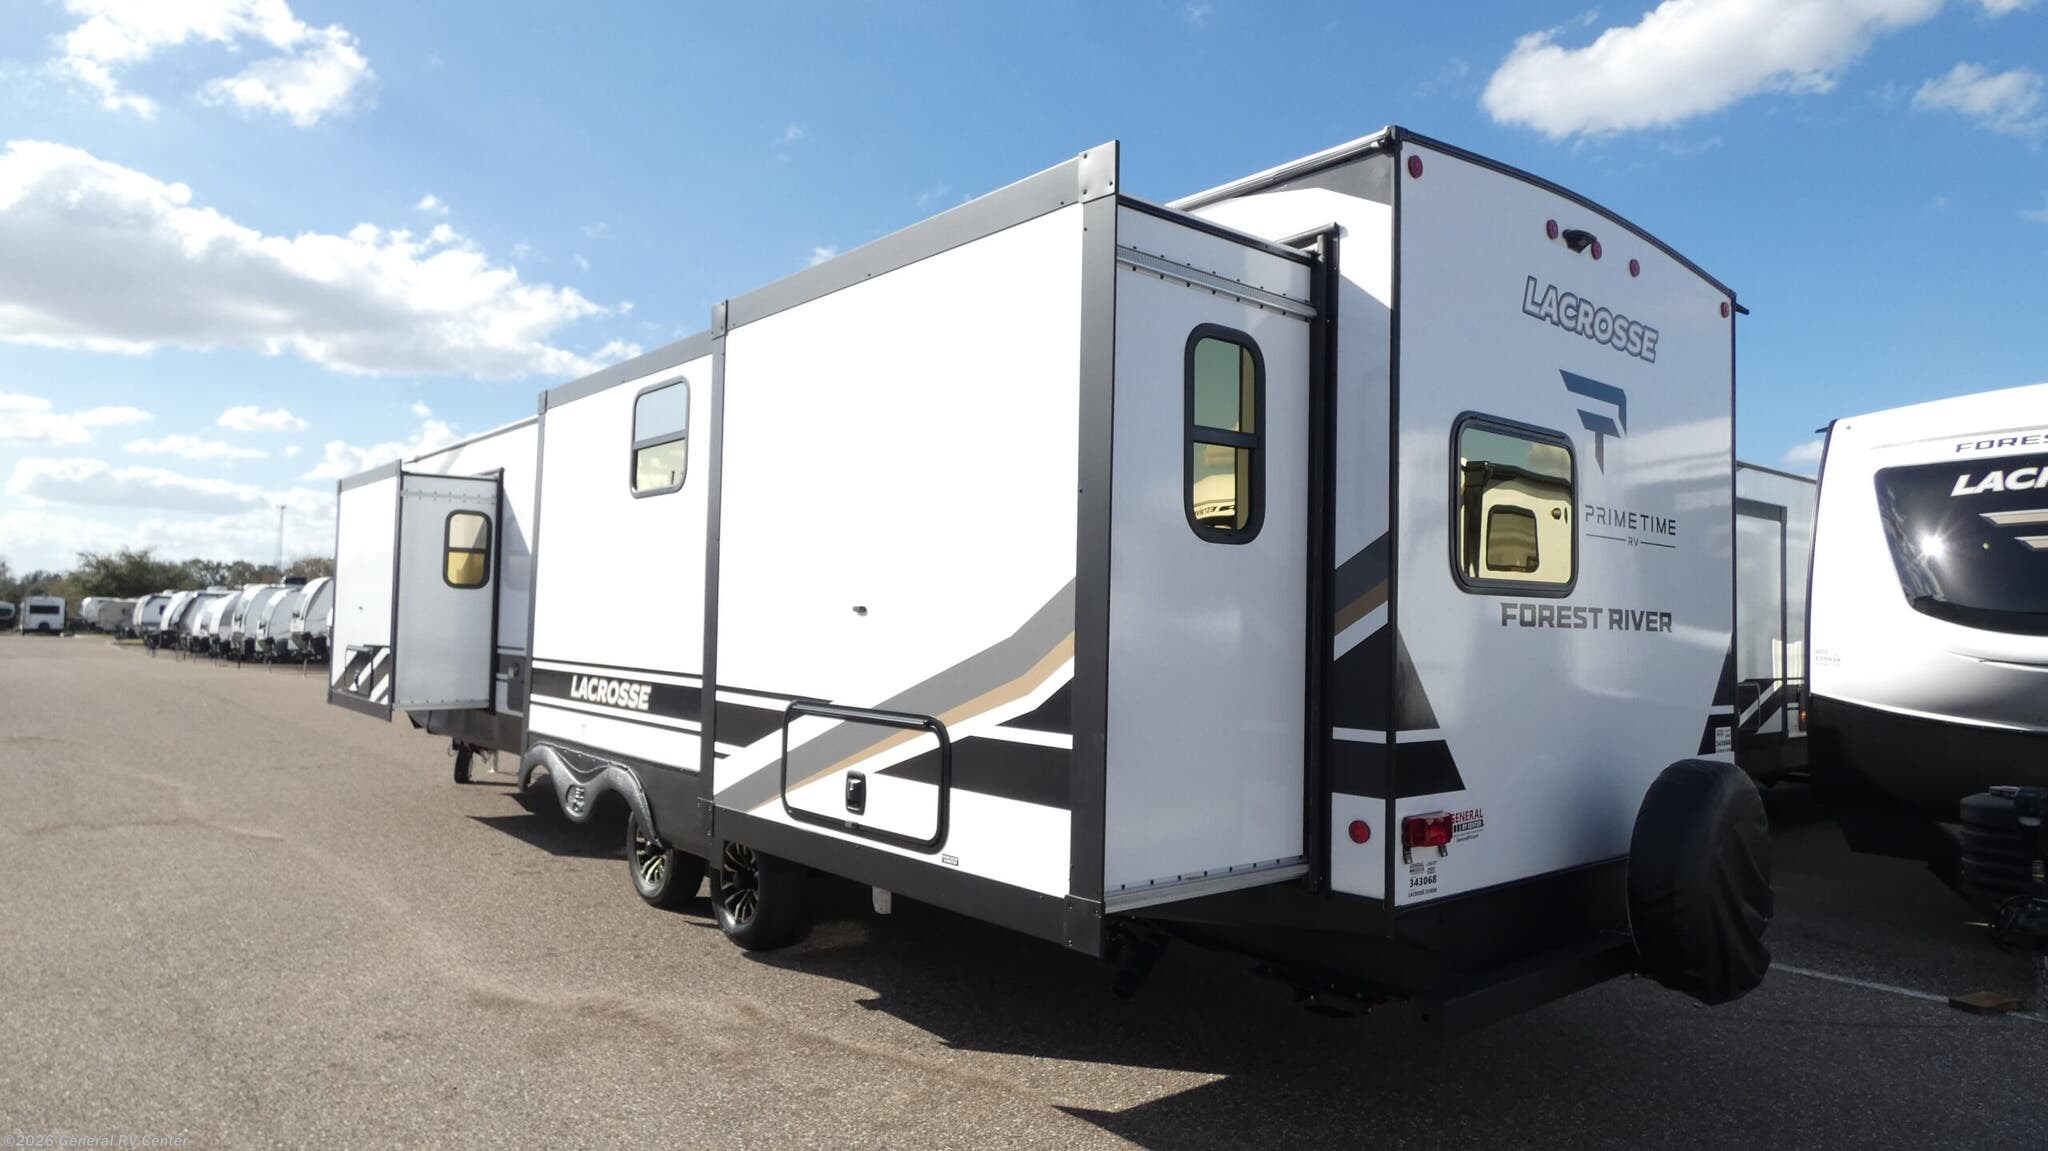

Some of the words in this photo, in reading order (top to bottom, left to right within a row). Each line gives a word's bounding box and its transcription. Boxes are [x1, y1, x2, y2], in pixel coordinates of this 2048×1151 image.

[1522, 275, 1659, 364] LACROSSE
[1627, 536, 1639, 547] RV
[1500, 602, 1603, 630] FOREST
[1608, 607, 1673, 633] RIVER
[570, 674, 652, 711] LACROSSE
[1409, 874, 1438, 888] 343068
